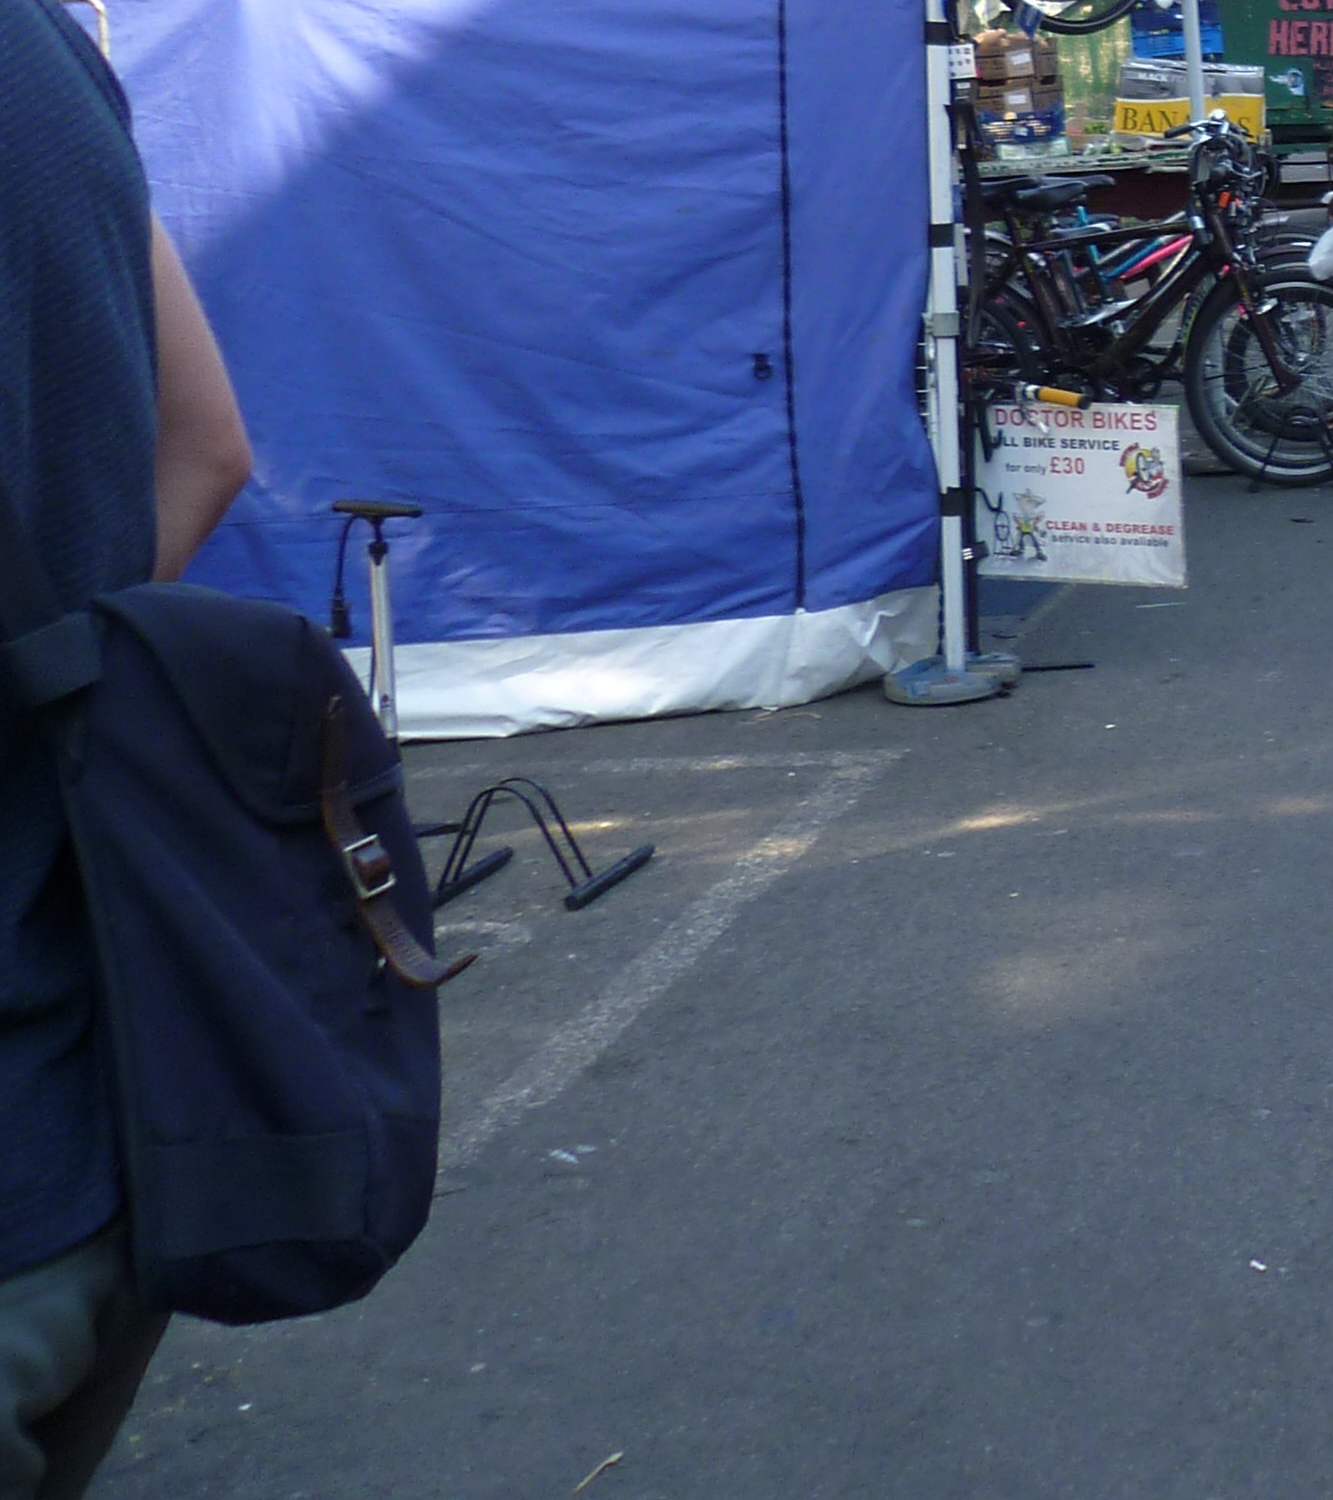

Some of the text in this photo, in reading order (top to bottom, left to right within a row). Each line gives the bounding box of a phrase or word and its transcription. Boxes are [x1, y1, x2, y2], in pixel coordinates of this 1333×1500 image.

[1093, 410, 1158, 431] BIKES
[1023, 437, 1055, 449] BIKE
[1060, 439, 1120, 451] SERVICE
[1050, 456, 1085, 475] £30
[1045, 520, 1087, 532] CLEAN
[1105, 523, 1175, 536] DEGREASE
